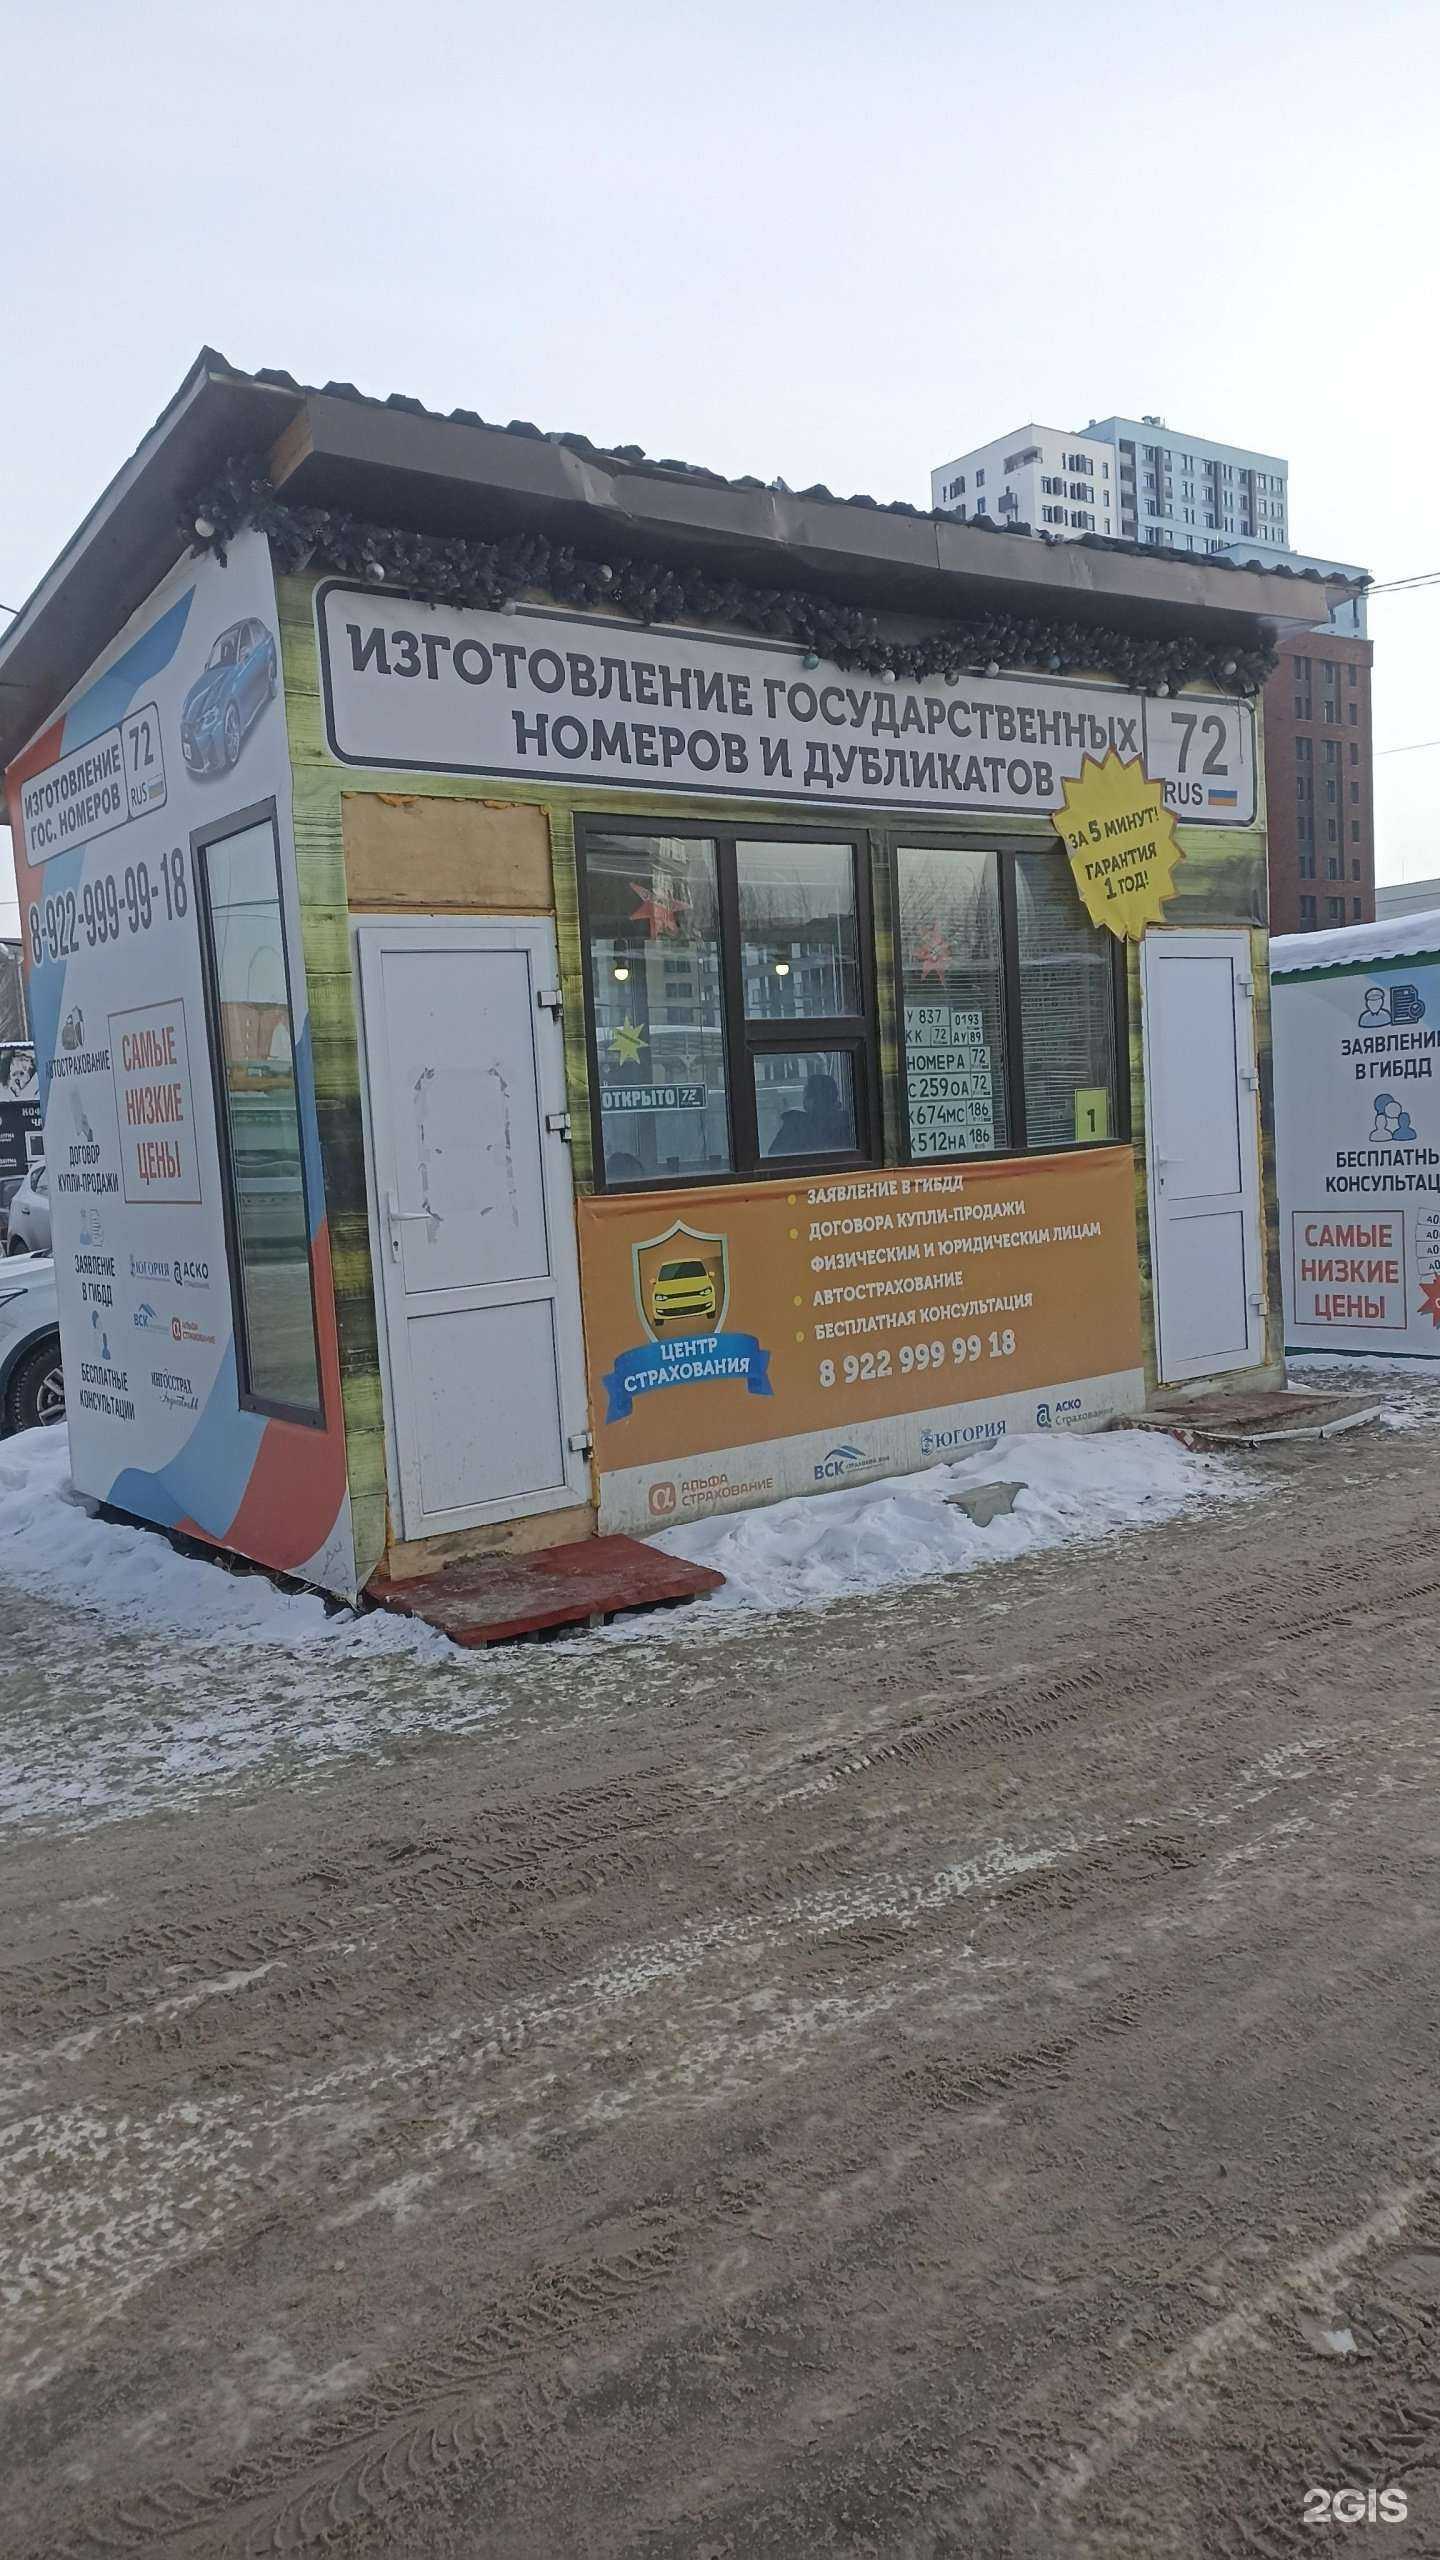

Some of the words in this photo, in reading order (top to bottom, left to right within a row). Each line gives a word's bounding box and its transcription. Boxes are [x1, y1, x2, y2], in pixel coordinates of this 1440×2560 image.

[346, 624, 753, 716] ИЗГОТОВЛЕНИЕ
[763, 678, 1138, 752] ГОСУДАРСТВЕННЫХ
[129, 720, 154, 771] 72
[512, 710, 749, 774] НОМЕРОВ
[760, 736, 792, 778] И
[804, 740, 1054, 797] ДУБЛИКАТОВ
[1171, 711, 1229, 776] 72
[24, 743, 122, 820] ИЗГОТОВЛЕНИЕ
[130, 782, 148, 807] RUS
[1165, 781, 1204, 806] RUS
[31, 817, 57, 851] ГОС.
[58, 782, 121, 837] НОМЕРОВ
[1068, 830, 1089, 849] ЗА
[1088, 819, 1102, 842] 5
[1103, 806, 1160, 838] МИНУТ!
[1085, 841, 1157, 880] ГАРАНТИЯ
[1104, 877, 1117, 900] 1
[1118, 870, 1150, 895] ГОД!
[29, 847, 189, 965] 8-922-999-99-18
[920, 1009, 942, 1025] 837
[934, 1028, 946, 1040] 72
[970, 1031, 981, 1041] 89
[122, 1026, 178, 1072] САМЫЕ
[907, 1053, 966, 1071] НОМЕРА
[972, 1048, 986, 1063] 72
[46, 1050, 111, 1080] АВТОСТРАХОВАНИЕ
[1355, 1063, 1367, 1080] В
[1369, 1057, 1433, 1079] ГИБДД
[973, 1075, 987, 1090] 72
[125, 1083, 184, 1126] НИЗКИЕ
[601, 1089, 675, 1109] ОТКРЫТО
[681, 1088, 697, 1101] 72
[967, 1102, 989, 1116] 186
[1086, 1108, 1096, 1133] 1
[969, 1129, 990, 1143] 186
[69, 1144, 101, 1168] ДОГОВОР
[137, 1141, 182, 1186] ЦЕНЫ
[58, 1173, 119, 1195] КУПЛИ-ПРОДАЖИ
[807, 1180, 898, 1205] ЗАЯВЛЕНИЕ
[901, 1180, 912, 1195] В
[914, 1175, 964, 1194] ГИБДД
[809, 1216, 894, 1241] ДОГОВОРА
[897, 1200, 1026, 1229] КУПЛИ-ПРОДАЖИ
[810, 1244, 920, 1273] ФИЗИЧЕСКИМ
[923, 1242, 935, 1257] И
[938, 1228, 1050, 1255] ЮРИДИЧЕСКИМ
[1052, 1221, 1102, 1242] ЛИЦАМ
[1305, 1224, 1393, 1248] САМЫЕ
[75, 1253, 116, 1278] ЗАЯВЛЕНИЕ
[184, 1261, 209, 1280] АСКО
[1301, 1259, 1400, 1284] НИЗКИЕ
[82, 1282, 88, 1301] В
[88, 1283, 113, 1308] ГИБДД
[813, 1270, 964, 1307] АВТОСТРАХОВАНИЕ
[815, 1310, 917, 1341] БЕСПЛАТНАЯ
[920, 1292, 1034, 1323] КОНСУЛЬТАЦИЯ
[1314, 1293, 1385, 1321] ЦЕНЫ
[660, 1337, 718, 1362] ЦЕНТР
[818, 1359, 834, 1388] 8
[843, 1350, 893, 1385] 922
[899, 1341, 945, 1376] 999
[951, 1334, 983, 1364] 99
[988, 1329, 1017, 1360] 18
[81, 1362, 129, 1392] БЕСПЛАТНЫЕ
[624, 1357, 751, 1393] СТРАХОВАНИЯ
[79, 1390, 136, 1421] КОНСУЛЬТАЦИИ
[1055, 1398, 1082, 1412] АСКО
[934, 1420, 1007, 1448] ЮГОРИЯ
[681, 1473, 728, 1492] АЛЬФА
[814, 1460, 845, 1481] ВСК
[681, 1478, 774, 1507] СТРАХОВАНИЕ
